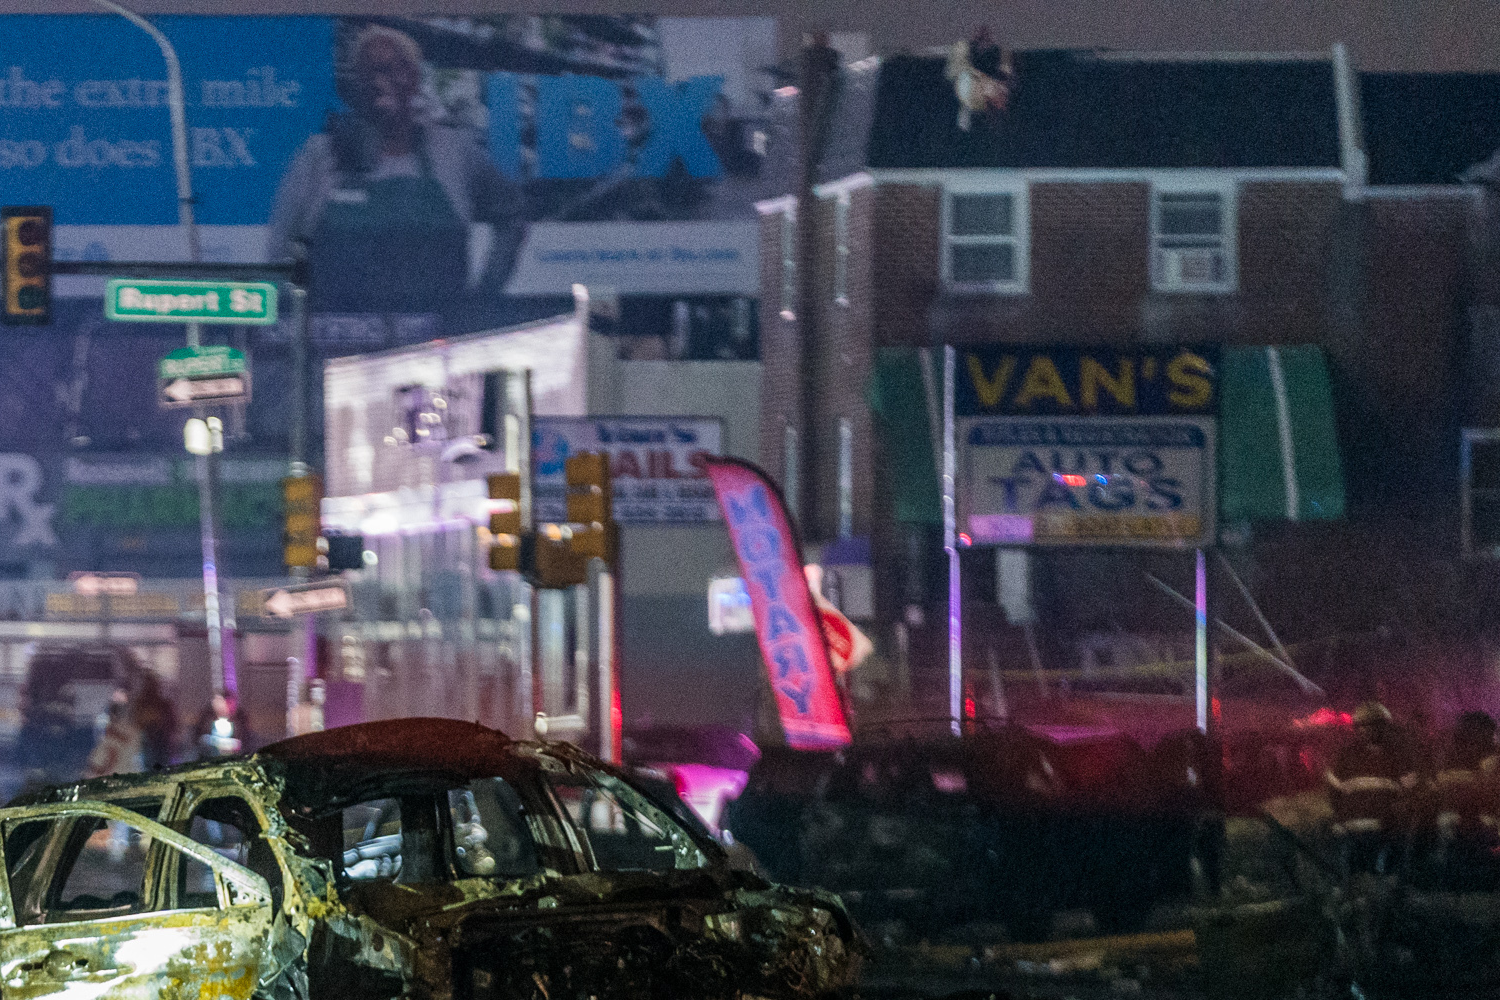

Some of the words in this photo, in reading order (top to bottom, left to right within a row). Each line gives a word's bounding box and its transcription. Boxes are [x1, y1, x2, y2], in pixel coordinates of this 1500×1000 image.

[74, 79, 176, 108] extr
[200, 66, 301, 107] mile
[55, 125, 161, 168] does
[118, 286, 219, 314] Rupert
[230, 288, 263, 314] St
[967, 352, 1213, 407] VAN'S
[610, 450, 712, 478] AILS
[1011, 450, 1165, 475] AUTO
[988, 478, 1184, 511] TAGS
